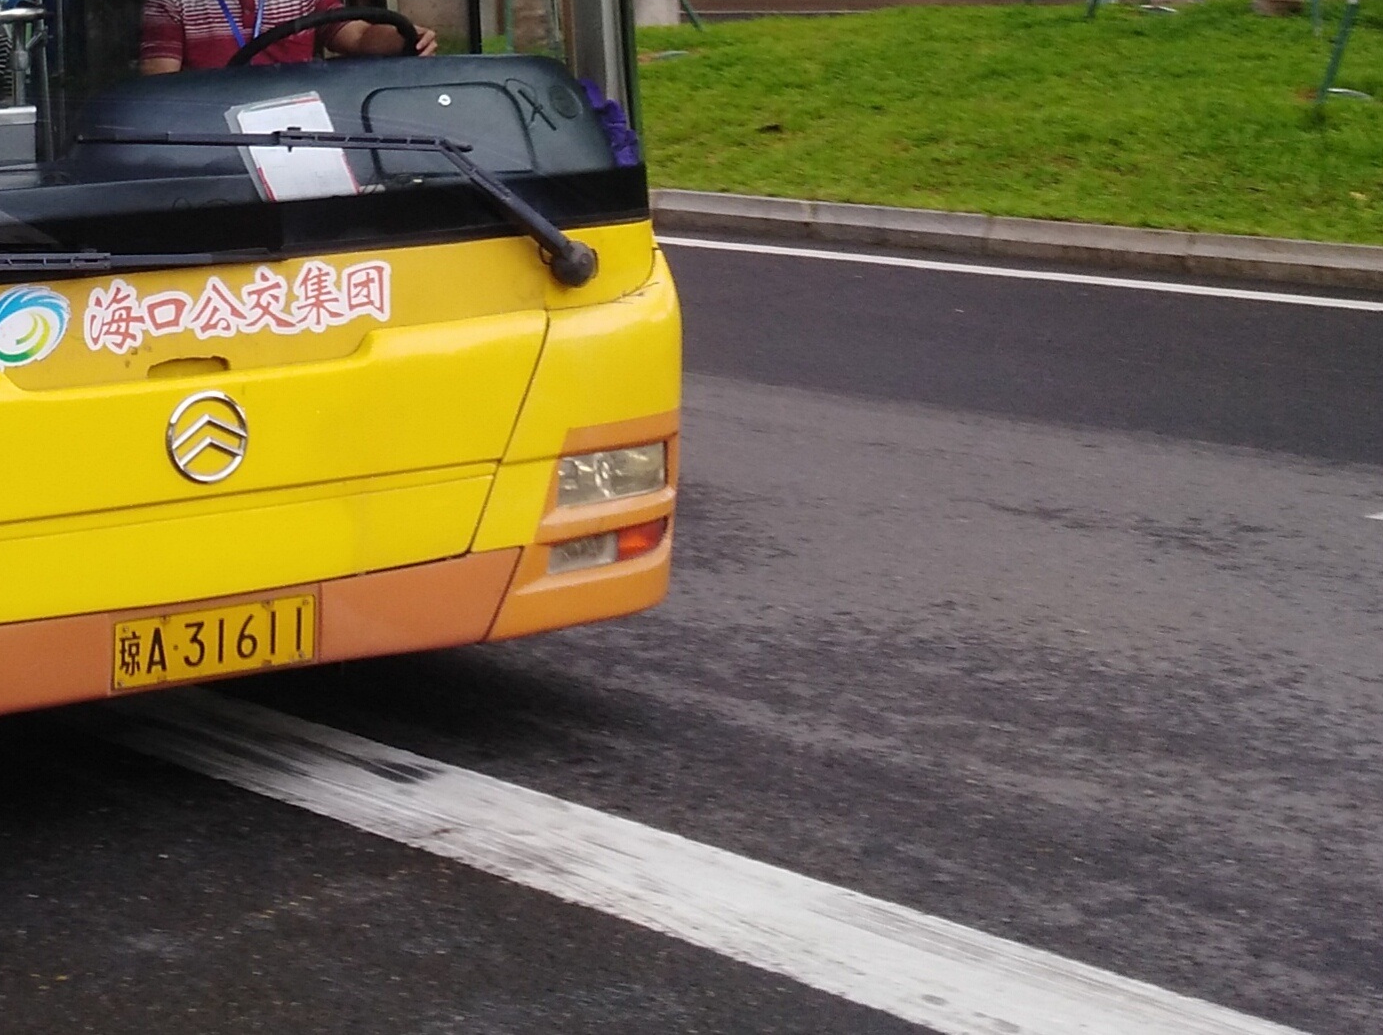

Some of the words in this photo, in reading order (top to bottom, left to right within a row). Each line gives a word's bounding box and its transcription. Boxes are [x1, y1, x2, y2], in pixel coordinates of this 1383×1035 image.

[86, 262, 391, 353] 海口公交集团
